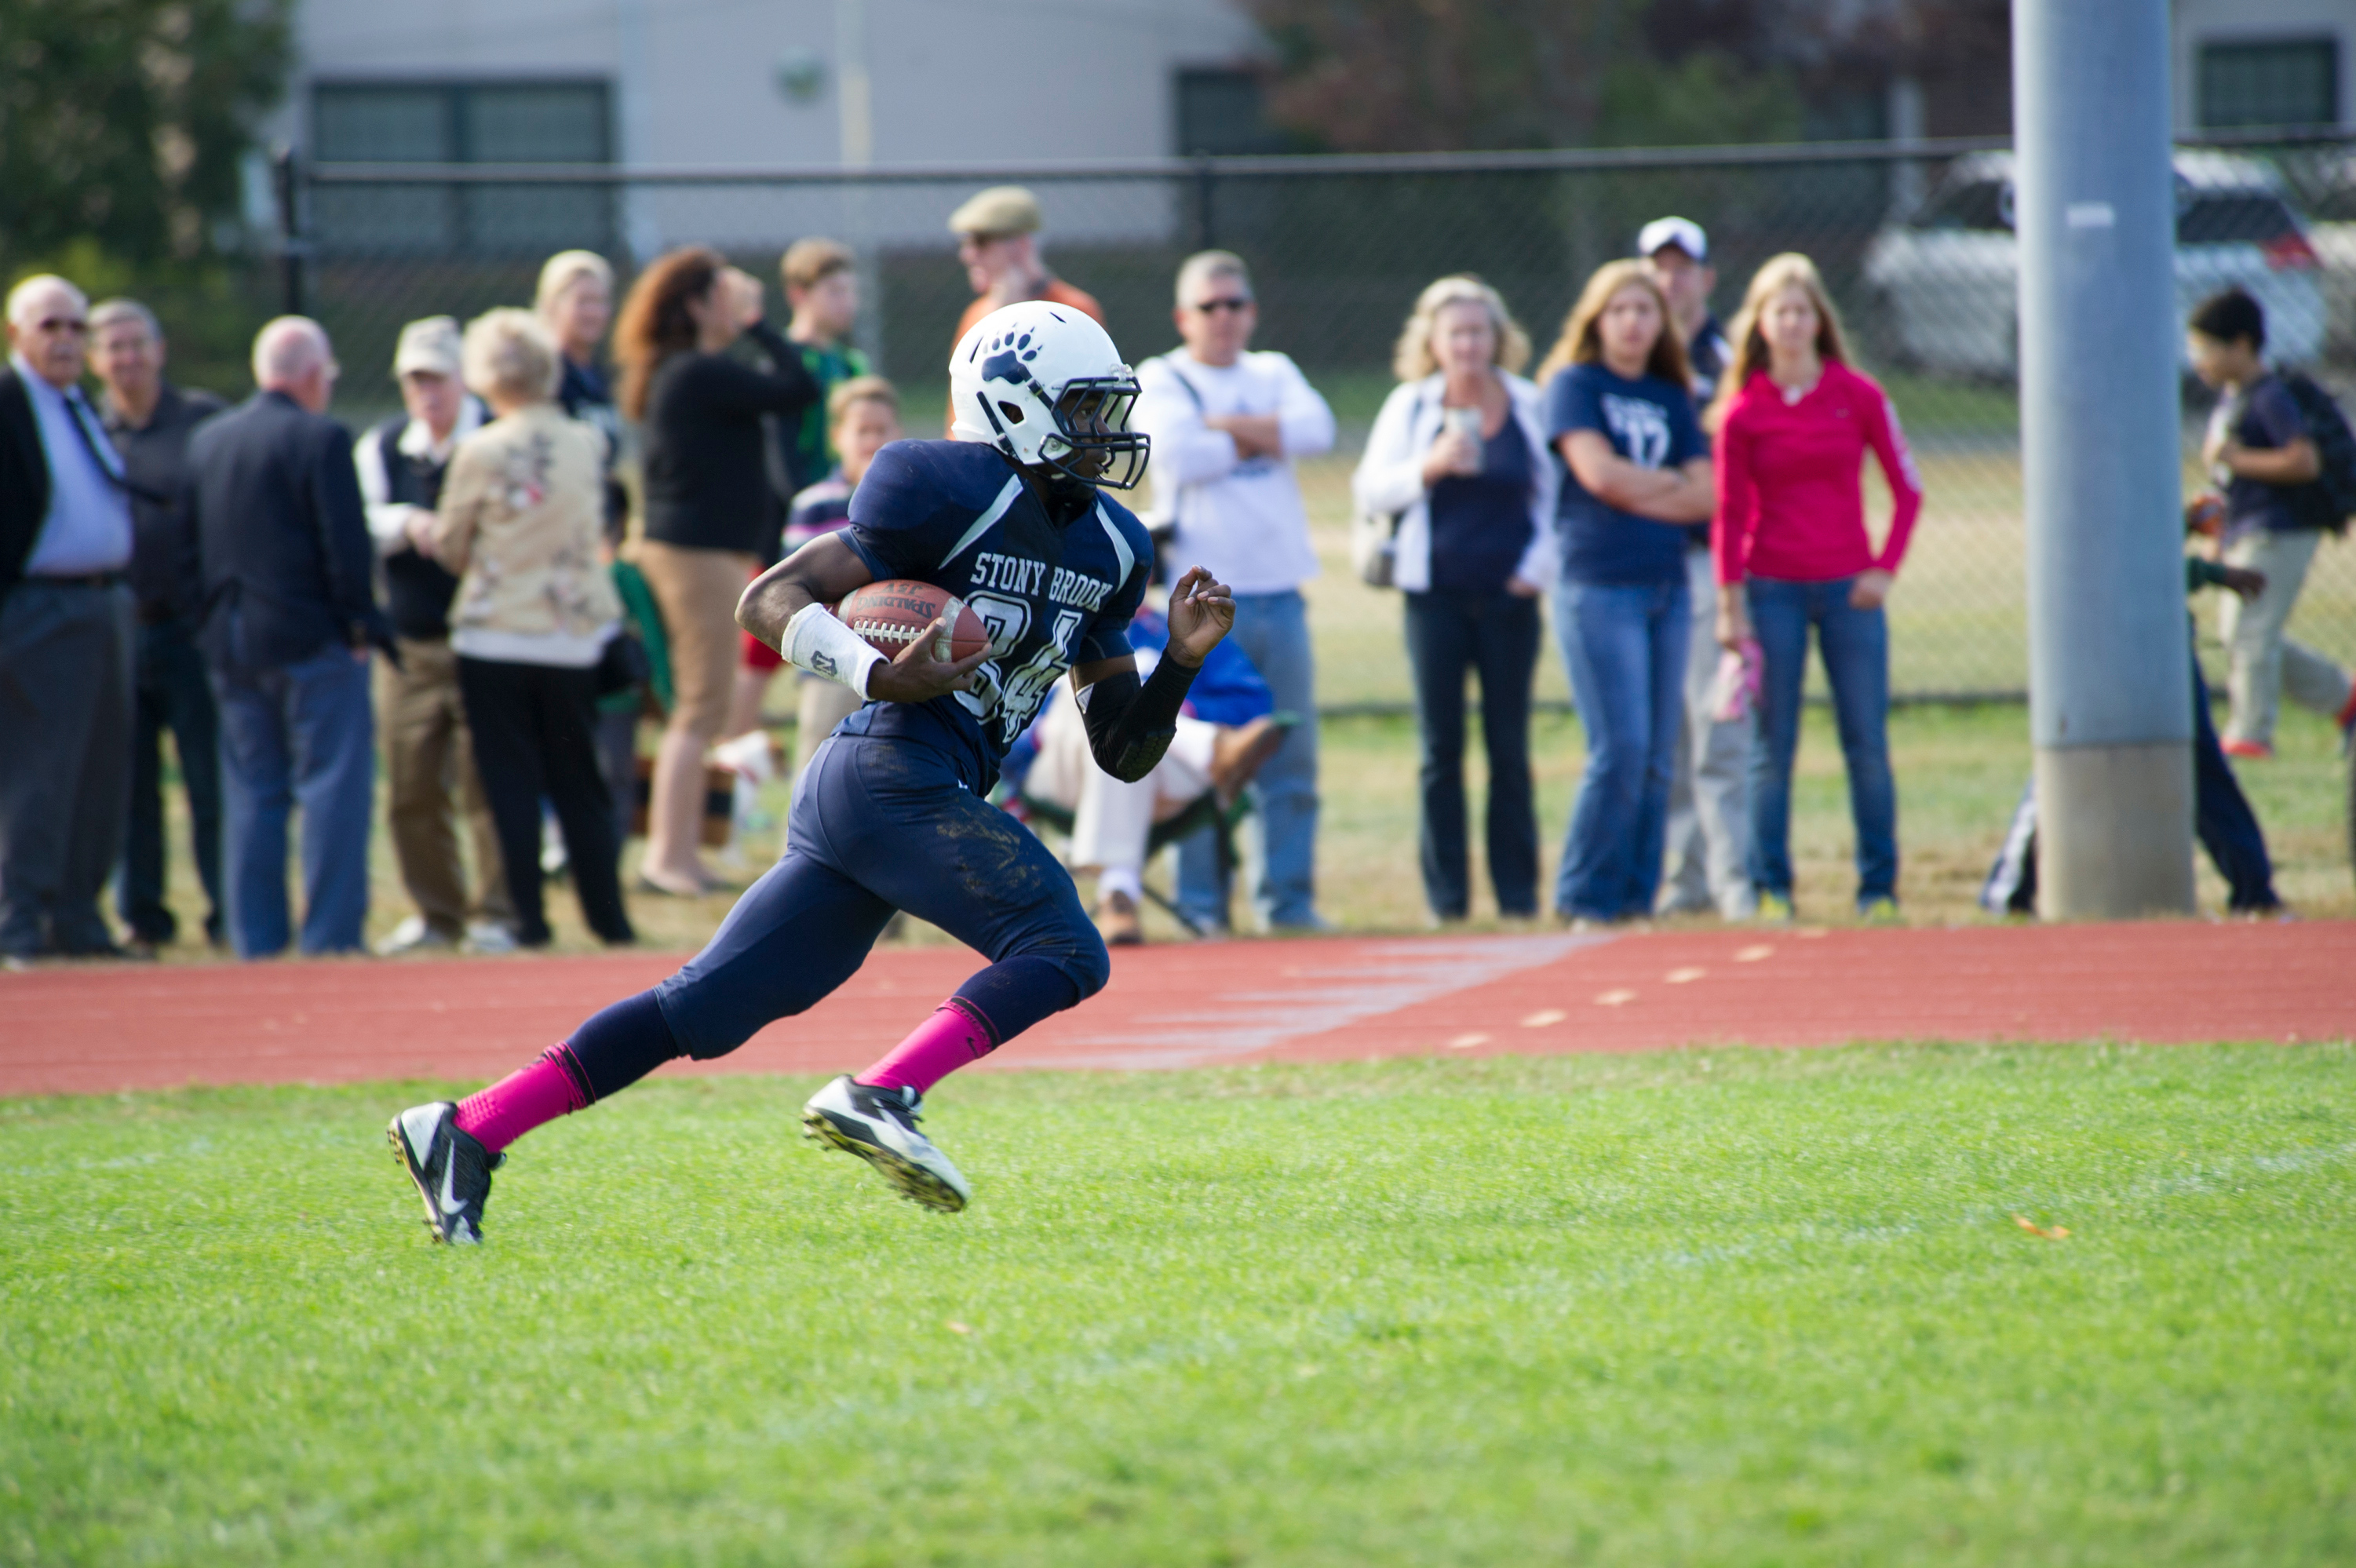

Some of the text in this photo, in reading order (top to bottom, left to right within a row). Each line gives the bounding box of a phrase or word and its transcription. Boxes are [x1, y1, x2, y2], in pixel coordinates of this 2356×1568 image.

[970, 552, 1113, 613] STONY BROOK
[856, 596, 935, 618] SPALDING
